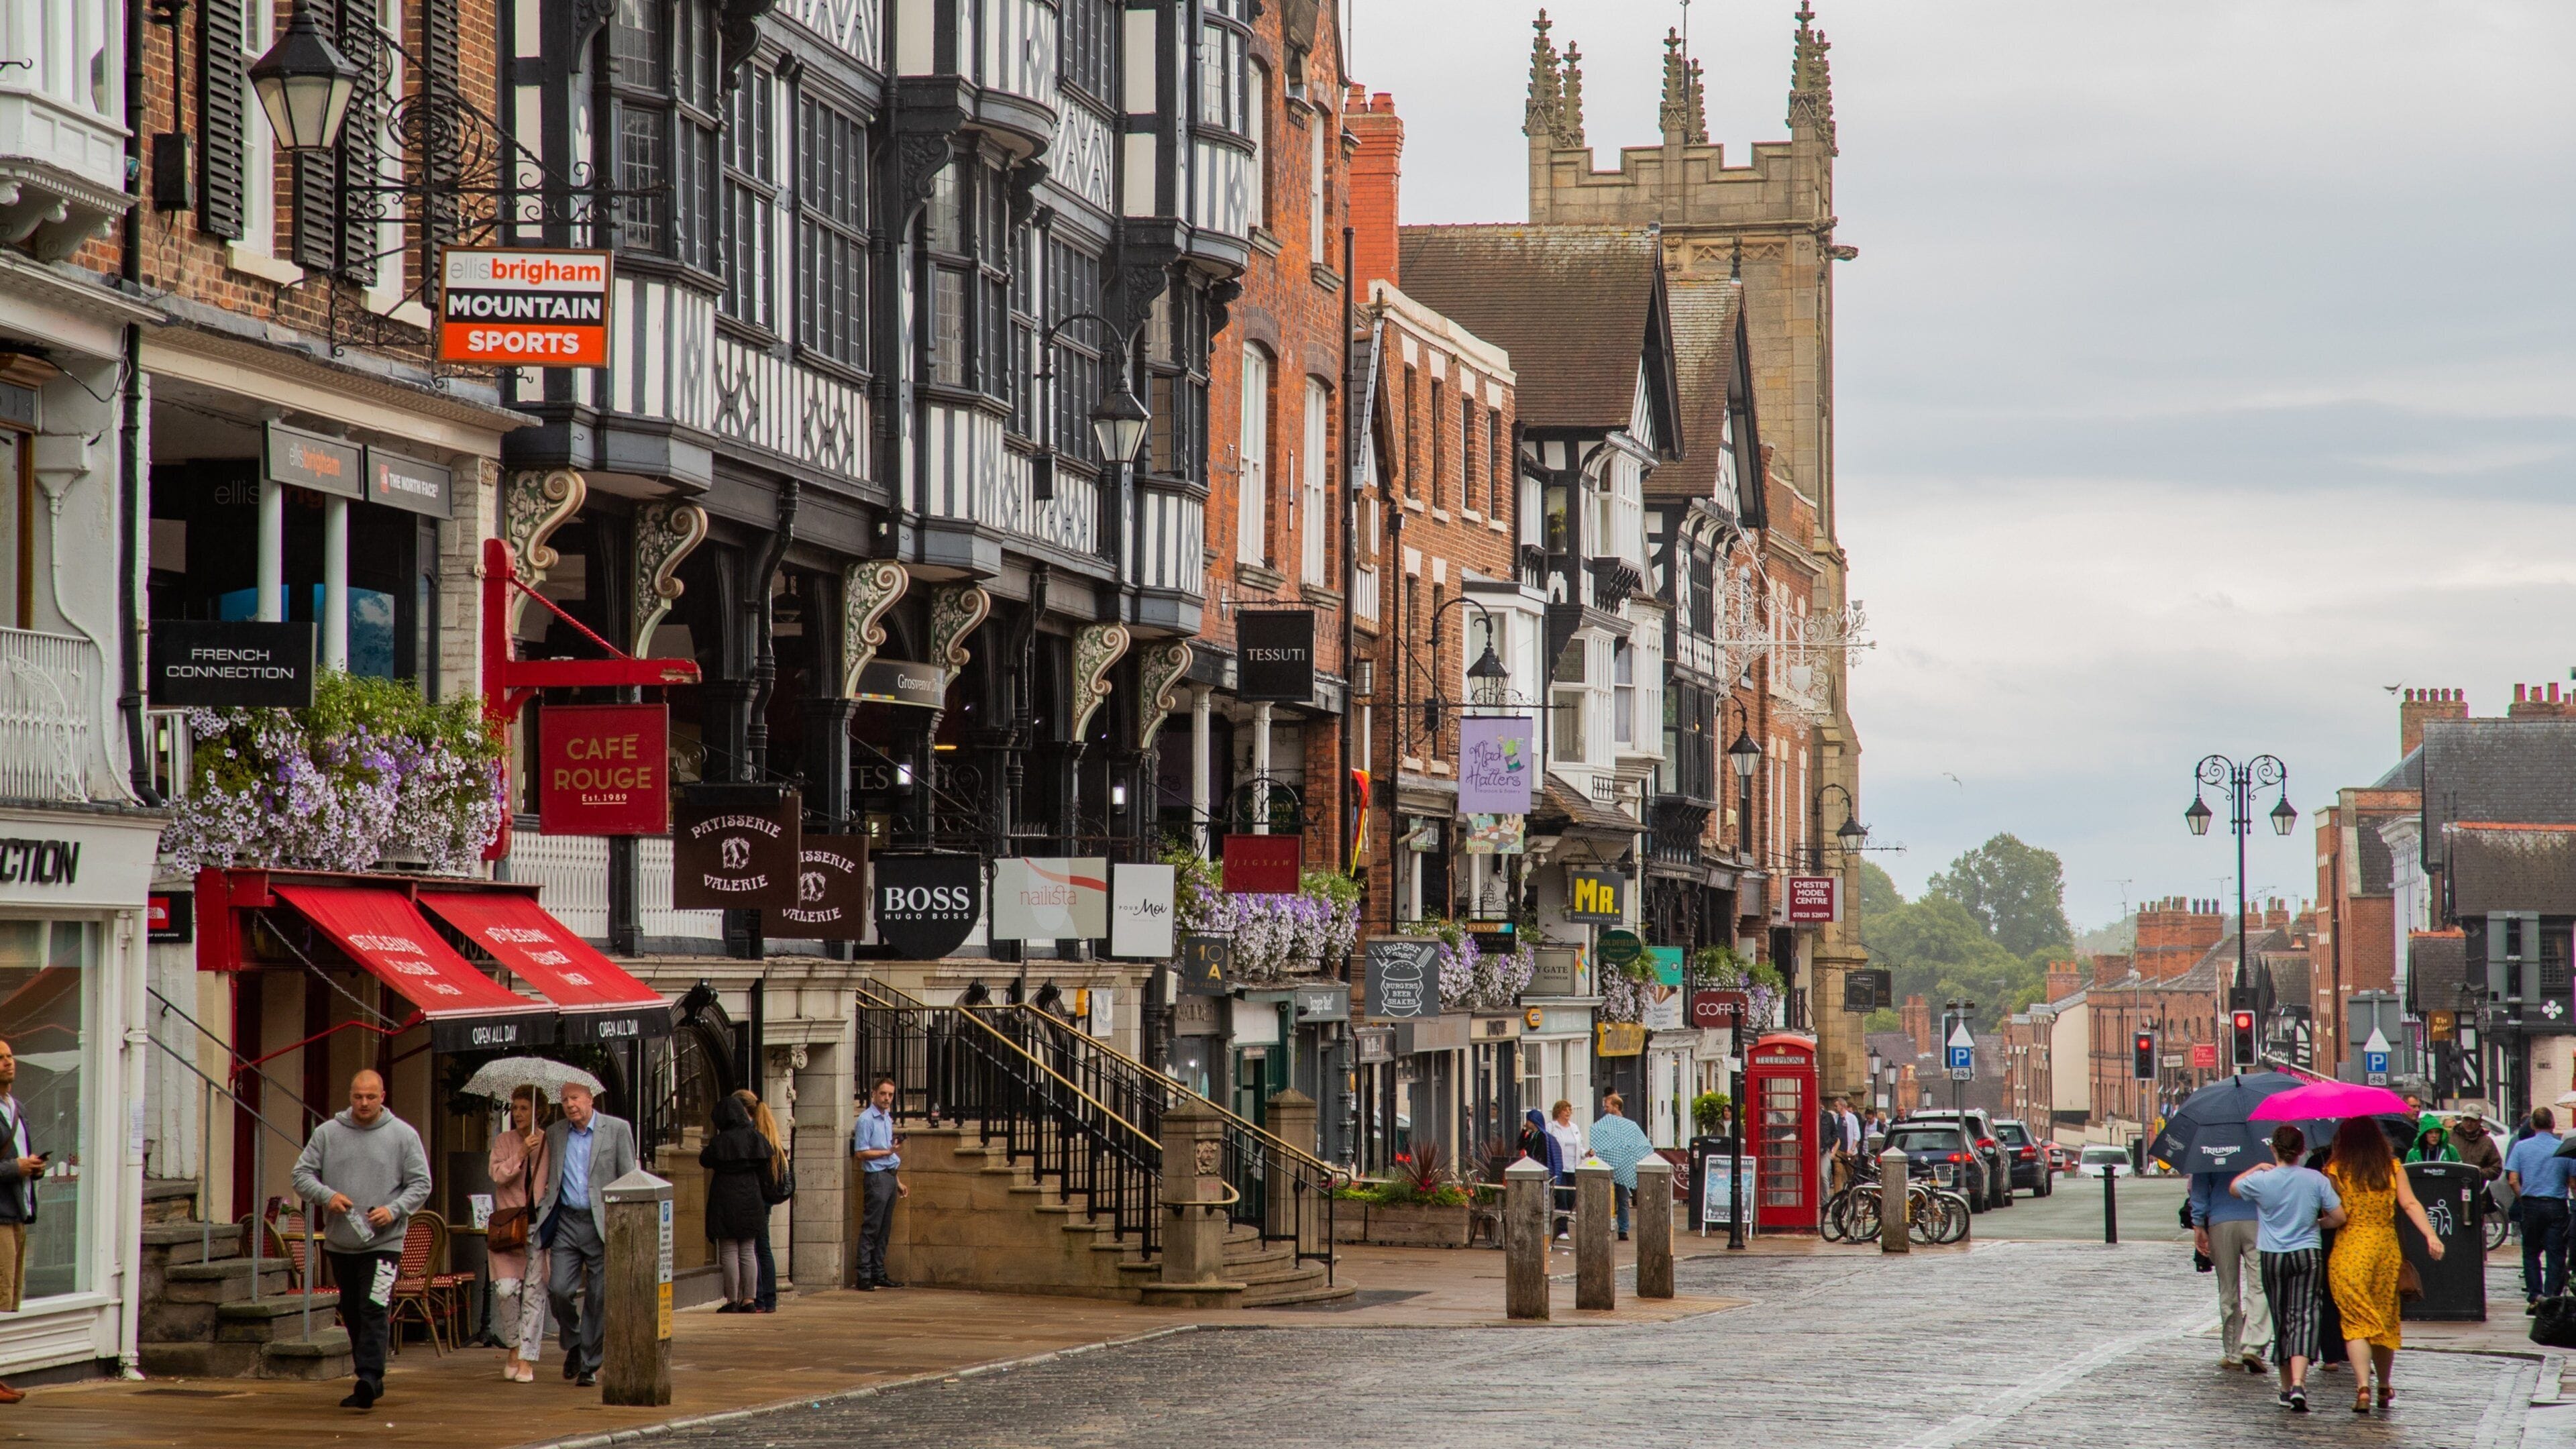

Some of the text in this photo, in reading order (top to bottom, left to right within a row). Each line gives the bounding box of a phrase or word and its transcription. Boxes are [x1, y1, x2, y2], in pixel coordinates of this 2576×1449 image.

[448, 294, 600, 319] MOUNTAIN
[468, 330, 580, 354] SPORTS
[389, 473, 400, 490] THE
[402, 476, 421, 494] NORTH
[191, 649, 270, 661] FRENCH
[1247, 649, 1305, 661] TESSUTI
[166, 665, 294, 679] CONNECTION
[898, 674, 932, 691] Grosvenor
[1469, 740, 1502, 771] Mad
[554, 767, 652, 790] ROUGE
[1466, 762, 1521, 792] Hatters
[691, 815, 781, 839] PATISSERIE
[0, 838, 80, 884] CTION
[1234, 859, 1291, 867] JIGSAW
[704, 874, 768, 892] VALERIE
[884, 886, 970, 911] BOSS
[1020, 885, 1077, 906] nailista
[1575, 878, 1620, 914] MR.
[782, 908, 842, 922] VALERIE
[1132, 898, 1168, 918] Moi
[1383, 943, 1421, 955] Burger
[1208, 963, 1222, 980] A
[1697, 1003, 1746, 1016] COFFE
[472, 1025, 517, 1044] OPEN ALL DAY
[599, 1019, 639, 1038] OPEN ALL DAY
[1955, 1049, 1968, 1065] P
[2371, 1054, 2384, 1071] P
[2200, 1146, 2240, 1157] TRIUMPH
